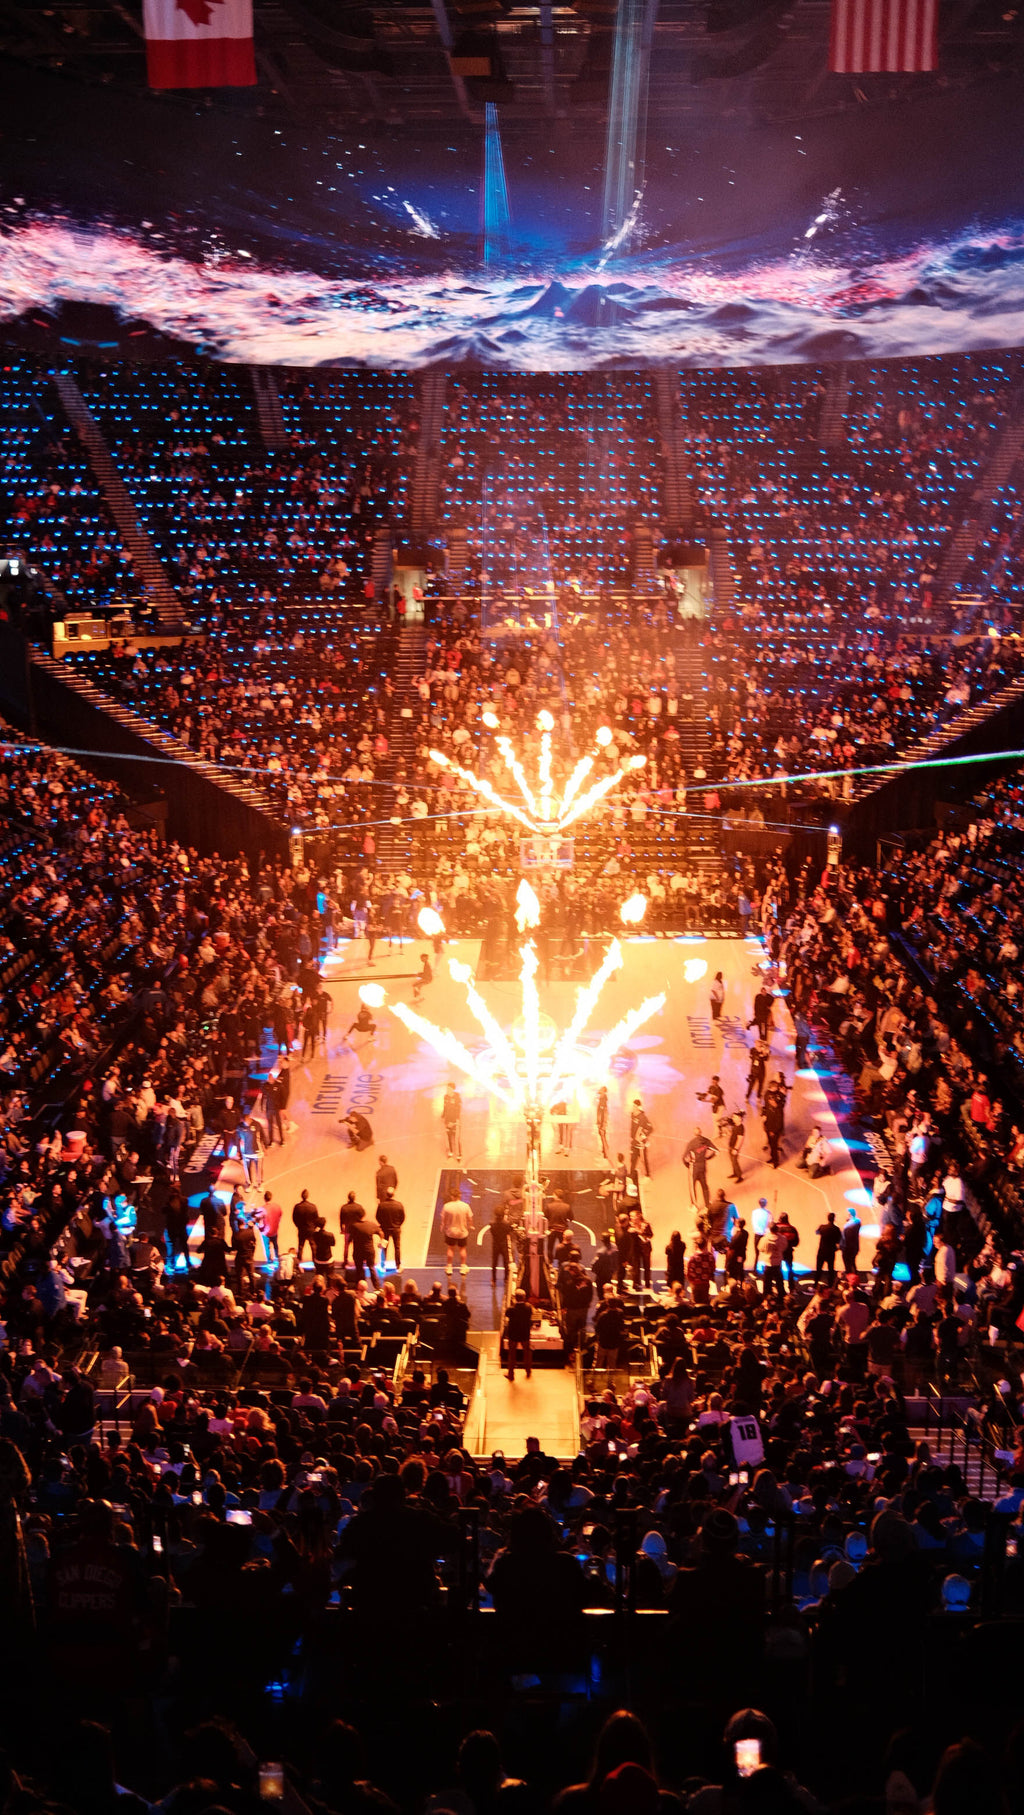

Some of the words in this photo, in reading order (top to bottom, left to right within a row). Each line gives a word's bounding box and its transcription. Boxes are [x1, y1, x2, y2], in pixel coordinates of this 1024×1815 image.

[737, 1423, 758, 1441] 18
[56, 1564, 80, 1587] SAN
[83, 1564, 122, 1588] DIEGO
[58, 1592, 117, 1610] CLIPPERS
